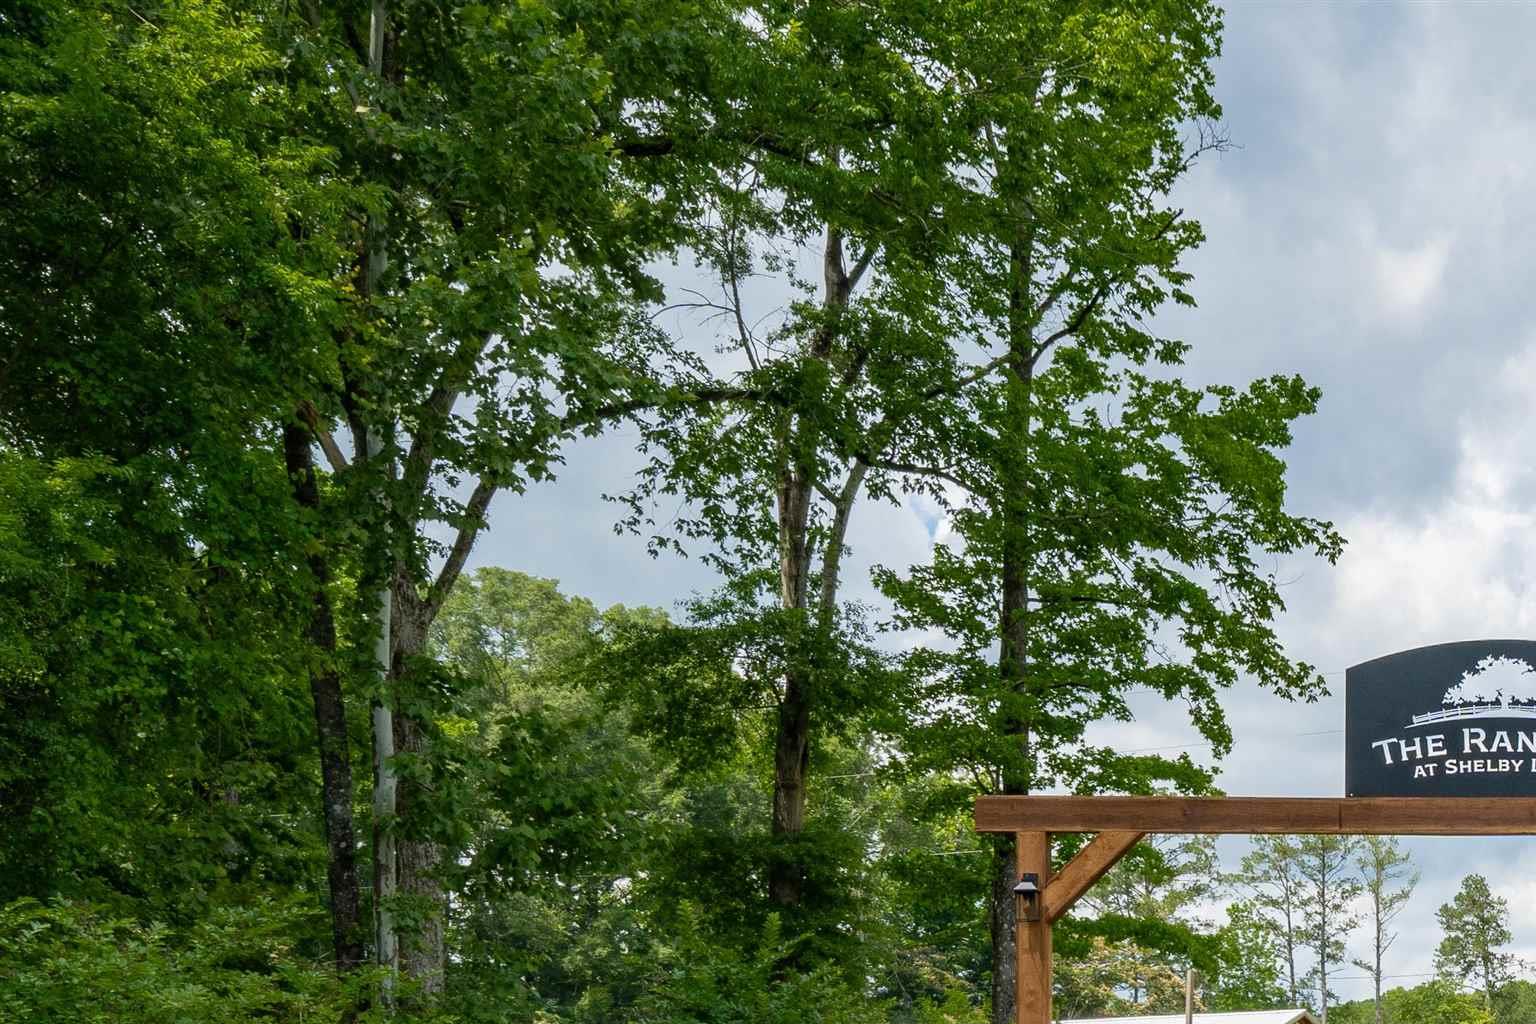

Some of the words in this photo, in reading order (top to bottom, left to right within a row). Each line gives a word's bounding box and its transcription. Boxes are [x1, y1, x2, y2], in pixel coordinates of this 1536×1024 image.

[1371, 734, 1447, 764] THE
[1413, 763, 1437, 778] AT
[1445, 759, 1524, 775] SHELBY
